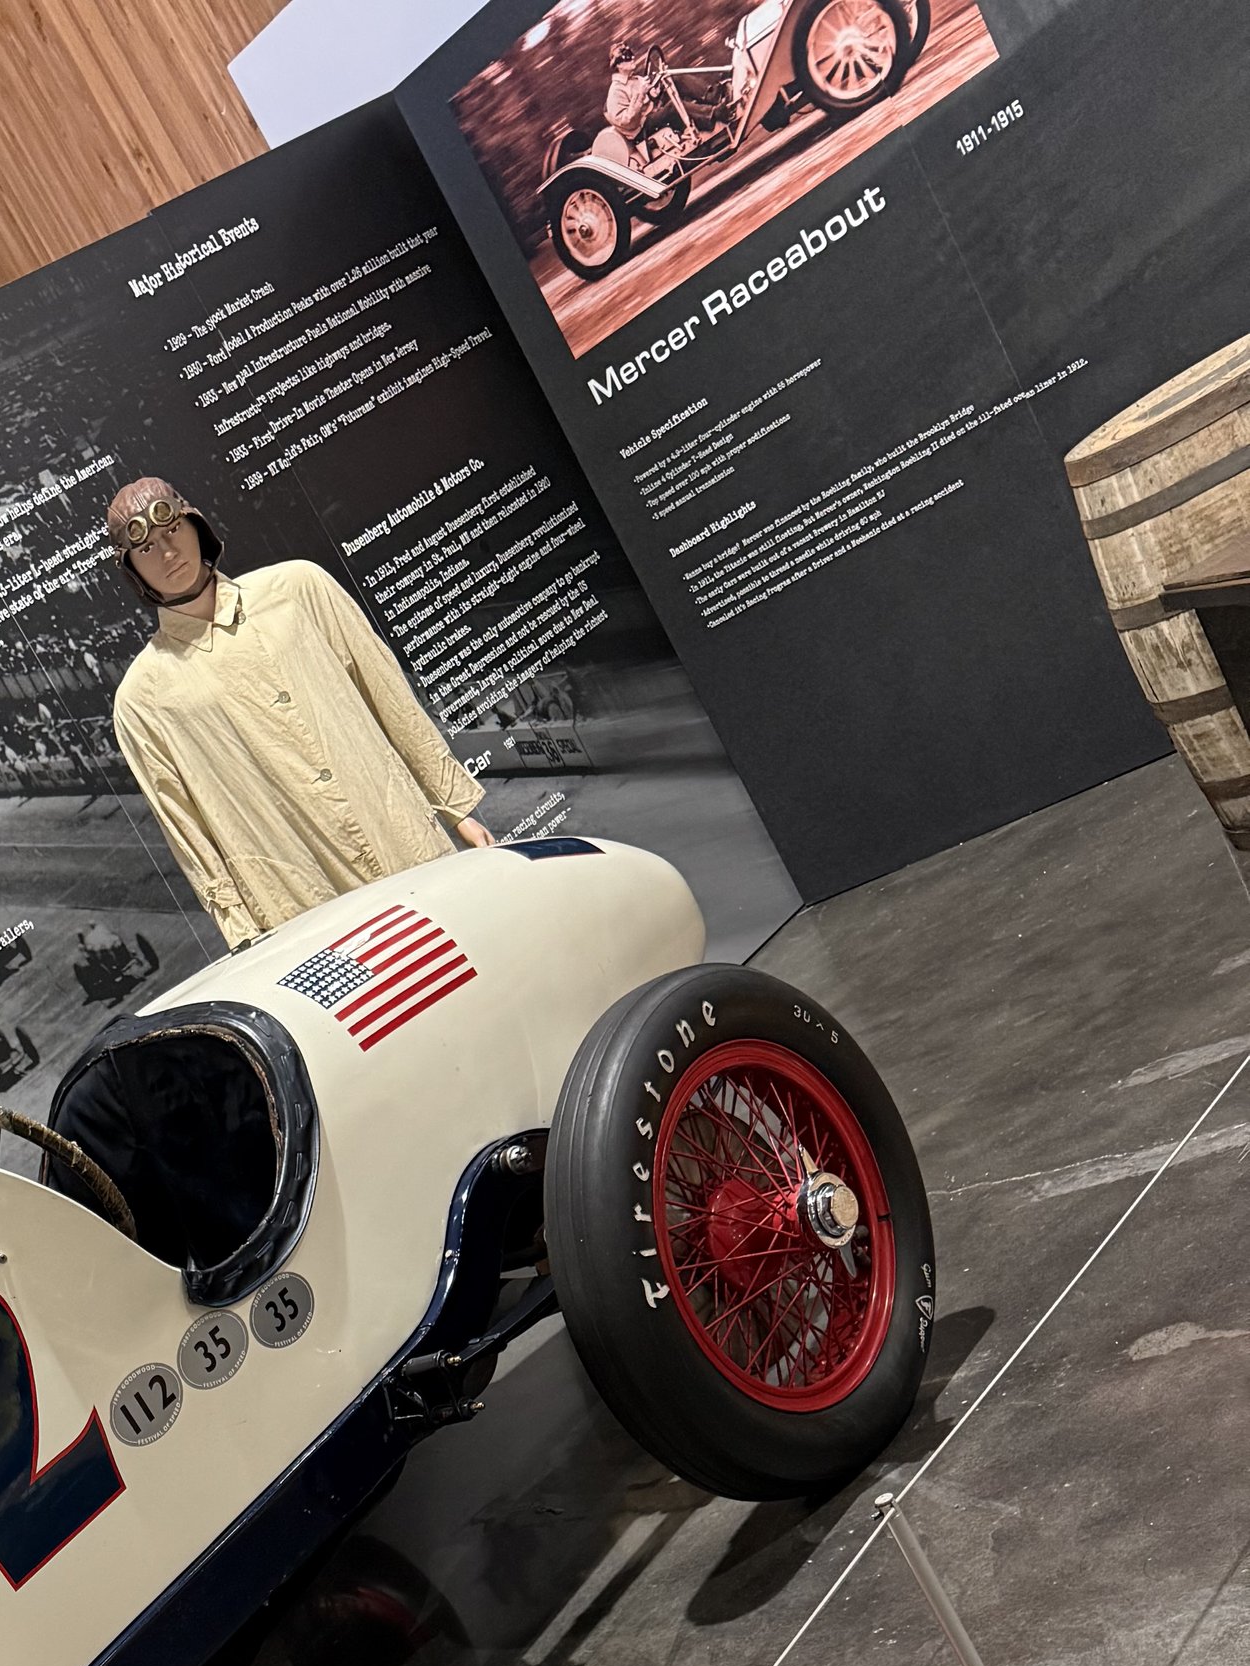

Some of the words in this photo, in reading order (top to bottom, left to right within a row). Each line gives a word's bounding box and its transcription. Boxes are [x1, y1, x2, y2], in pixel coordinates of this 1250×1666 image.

[956, 100, 1024, 155] 1911-1915
[128, 272, 163, 297] Major
[160, 234, 222, 281] Historical
[218, 217, 258, 245] Events
[266, 374, 300, 402] projects:
[297, 365, 317, 380] like
[314, 345, 349, 370] highways
[348, 335, 363, 350] and
[360, 322, 391, 342] bridges.
[341, 520, 390, 556] Dusenberg
[464, 750, 491, 778] Car
[831, 1030, 838, 1044] 5
[632, 999, 717, 1309] Firestone
[266, 1287, 299, 1332] 35
[194, 1326, 231, 1372] 35
[120, 1375, 176, 1434] 112
